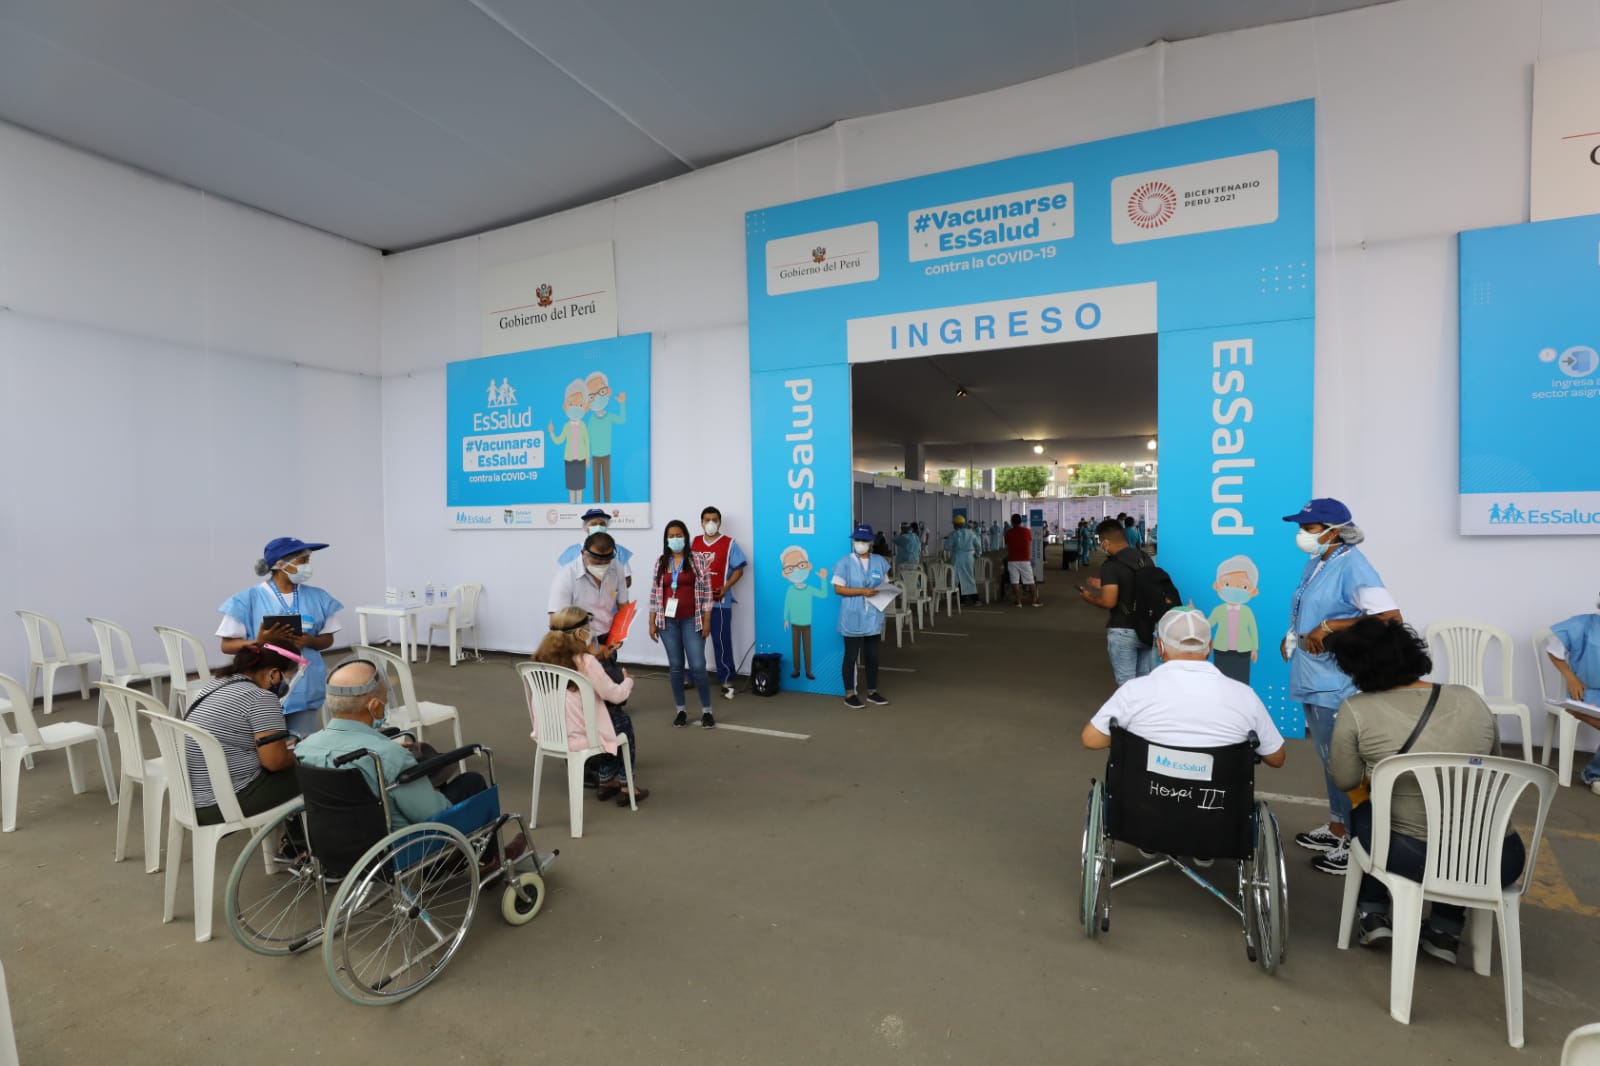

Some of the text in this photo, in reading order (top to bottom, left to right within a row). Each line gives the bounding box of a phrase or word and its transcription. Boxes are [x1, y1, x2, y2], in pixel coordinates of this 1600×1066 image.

[1184, 180, 1261, 199] BICENTENARIO
[1184, 193, 1236, 207] PERÚ 2021
[913, 193, 1068, 233] #Vacunarse
[938, 217, 1040, 252] EsSalud
[779, 257, 861, 280] Gobierno del Perú
[924, 245, 1057, 276] contra la COVID-19
[499, 300, 596, 330] Gobierno del Perú
[890, 302, 1102, 350] INGRESO
[473, 406, 532, 432] EsSalud
[466, 436, 541, 453] #Vacunarse
[1211, 338, 1255, 536] EsSalud
[477, 452, 528, 468] EsSalud
[784, 378, 815, 535] EsSalud
[469, 471, 538, 483] contra la COVID-19
[1172, 762, 1206, 772] EsSalud
